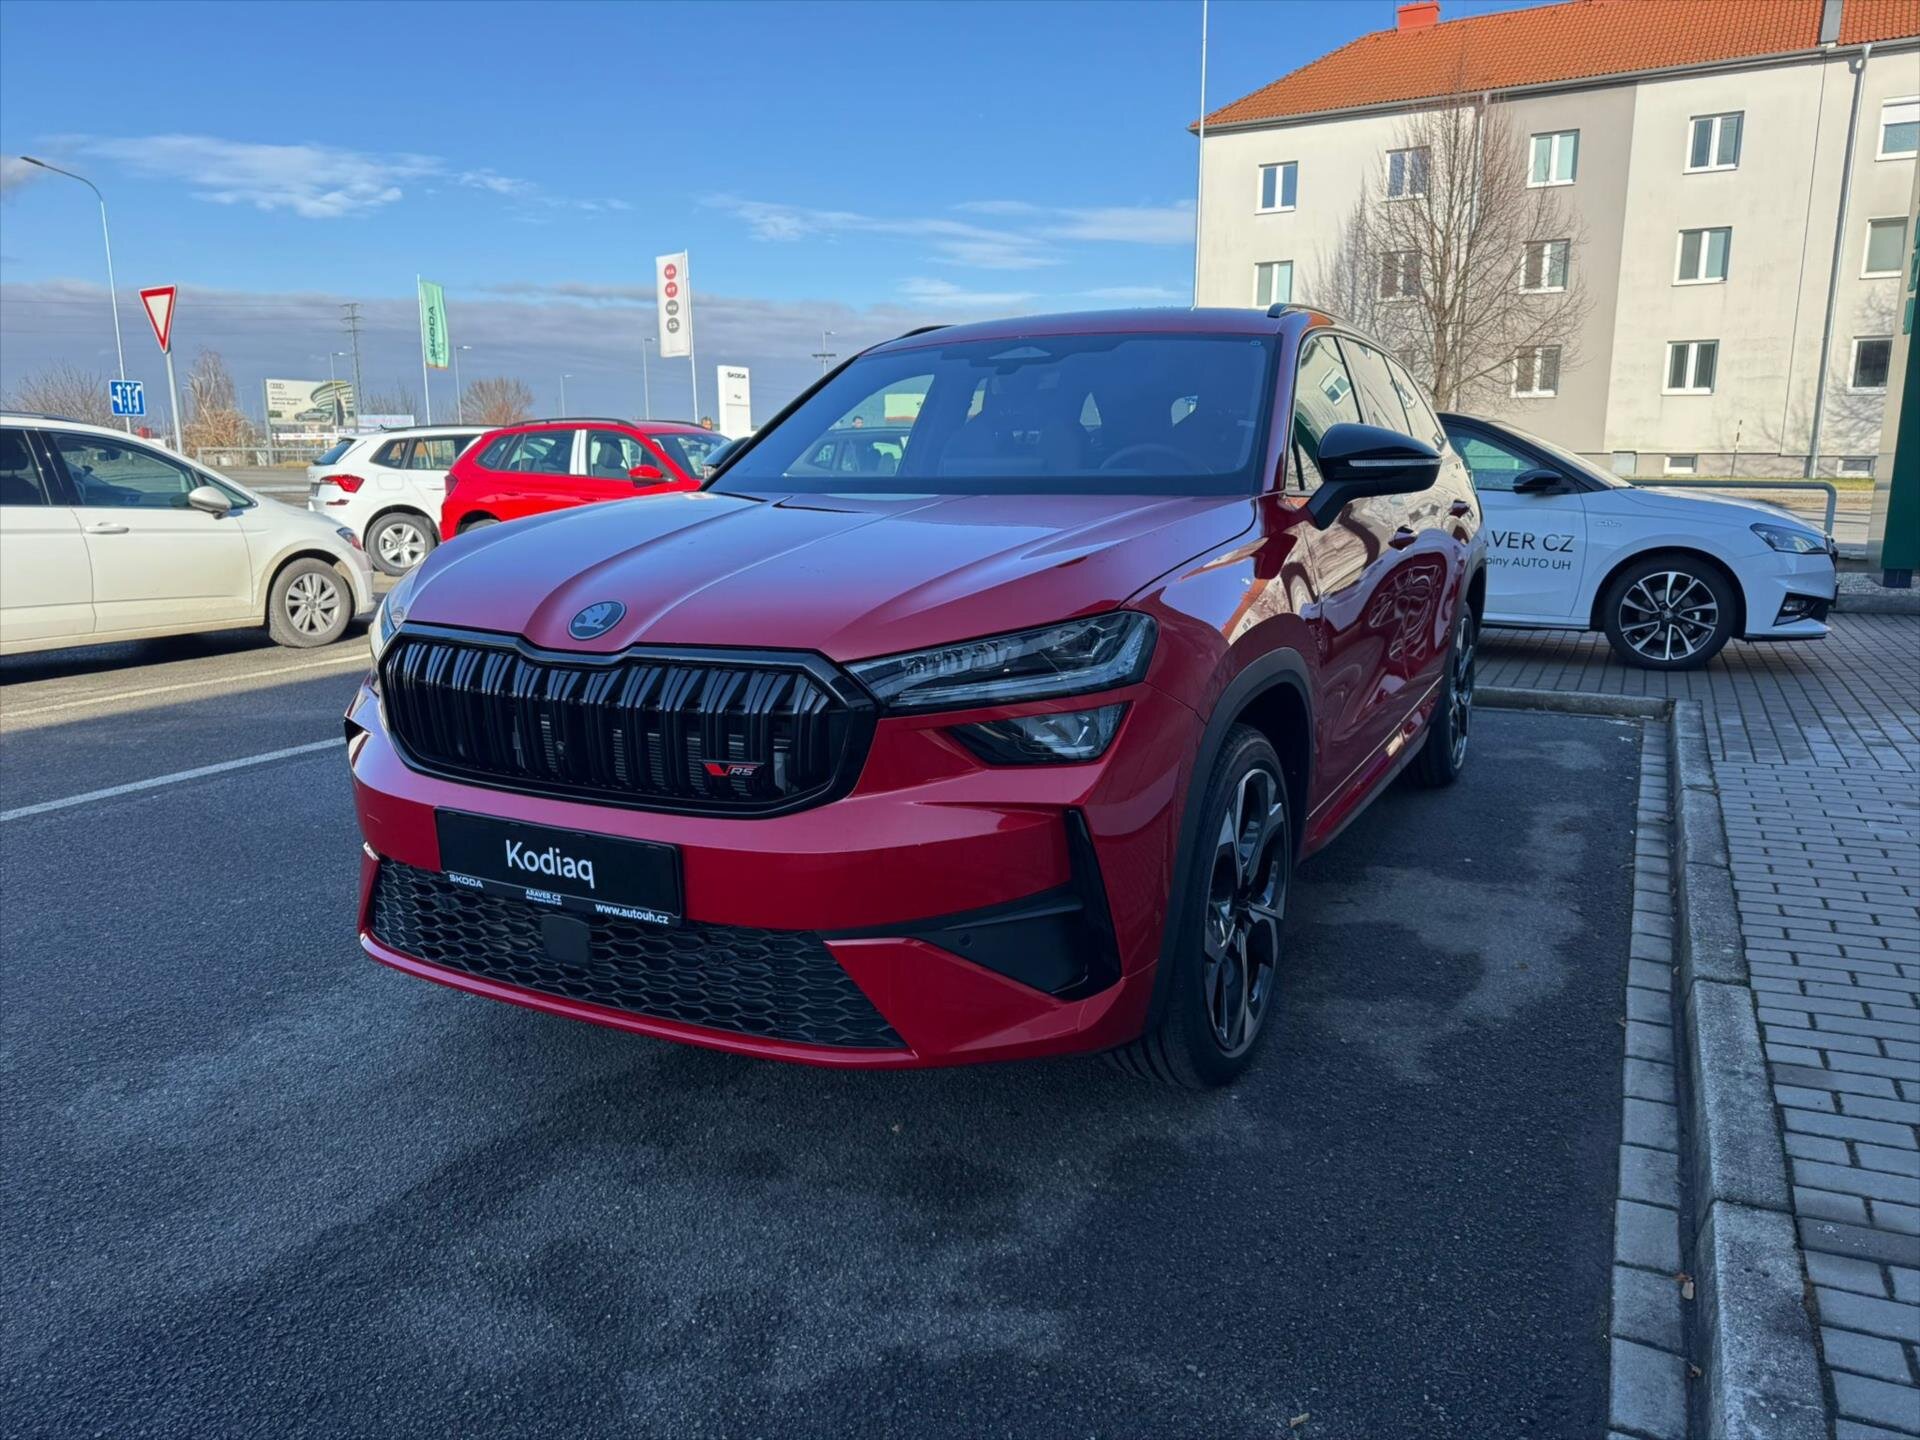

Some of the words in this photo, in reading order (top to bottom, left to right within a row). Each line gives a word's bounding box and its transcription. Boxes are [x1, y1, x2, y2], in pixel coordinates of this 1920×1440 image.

[1485, 530, 1535, 550] VER
[1543, 534, 1575, 553] CZ
[1486, 556, 1510, 568] piny
[1511, 557, 1548, 568] AUTO
[1551, 559, 1571, 570] UH
[505, 839, 595, 889] Kodiaq
[595, 903, 669, 925] www.autouh.cz
